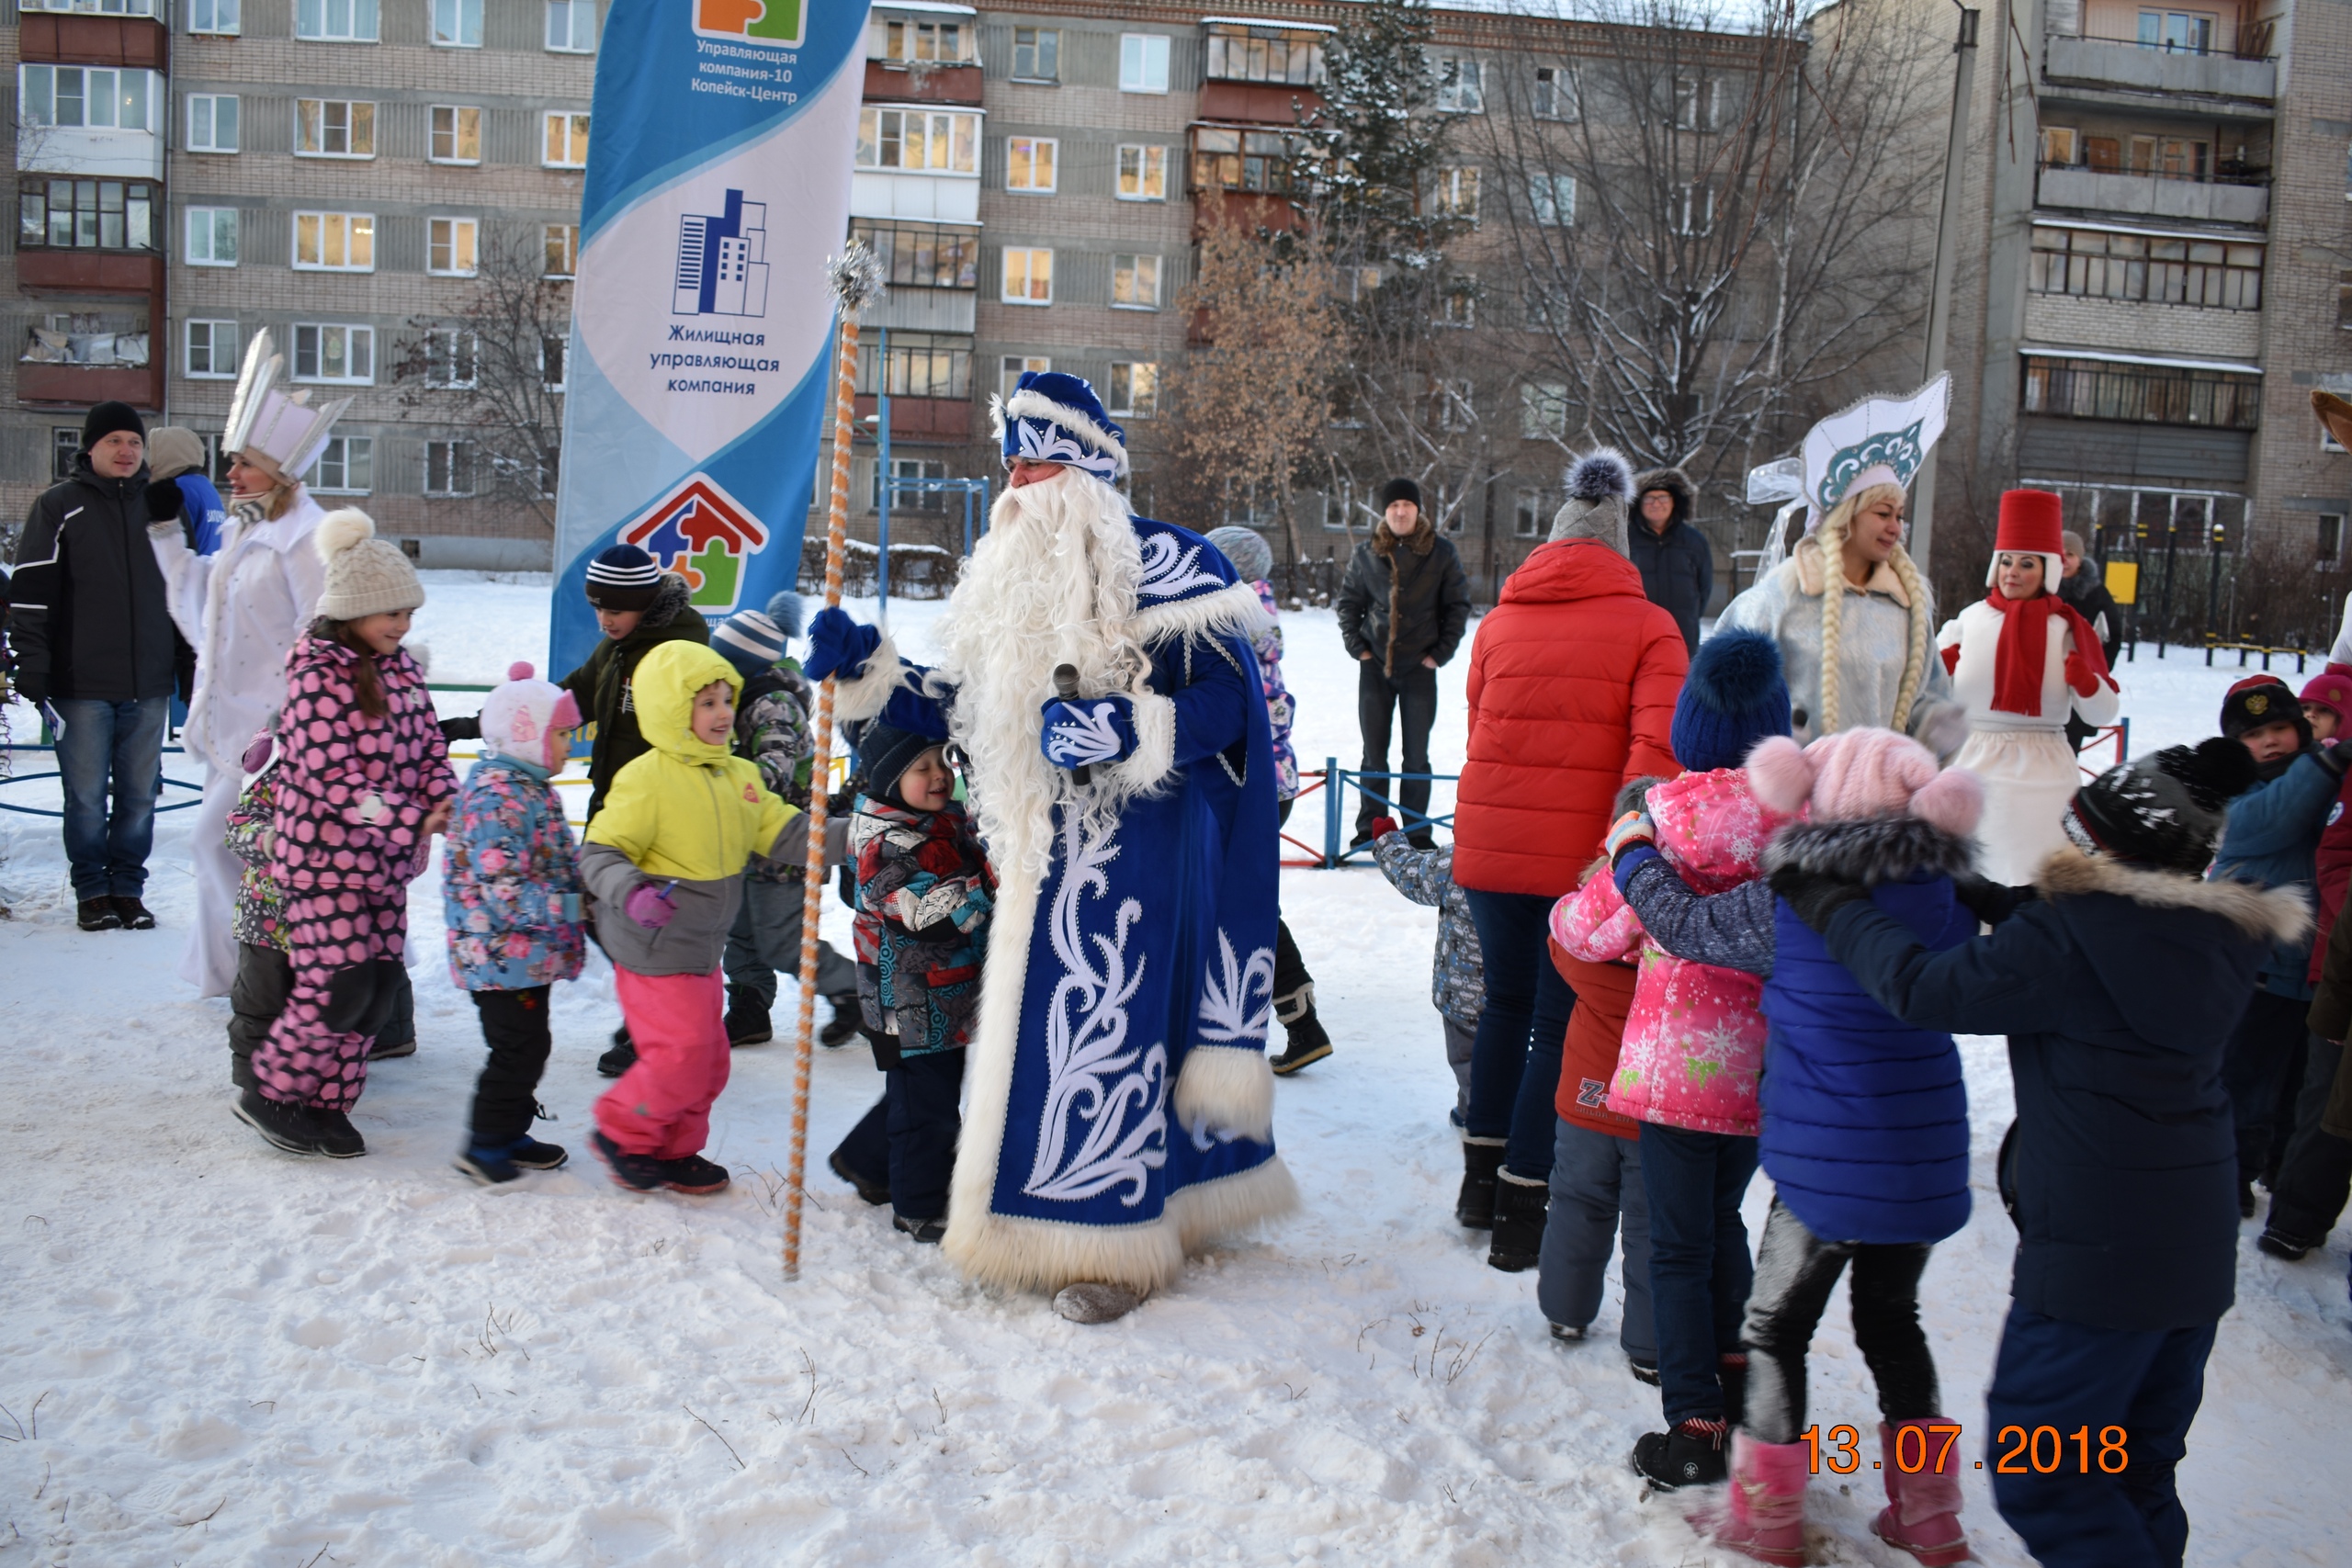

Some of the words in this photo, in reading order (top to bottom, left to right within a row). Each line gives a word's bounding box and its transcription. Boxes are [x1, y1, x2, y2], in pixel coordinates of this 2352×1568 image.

[696, 39, 797, 65] Управляющая
[699, 62, 793, 84] компания-10
[691, 77, 797, 106] Копейск-Центр
[668, 324, 765, 346] Жилищная
[650, 353, 780, 372] управляющая
[668, 379, 755, 395] компания
